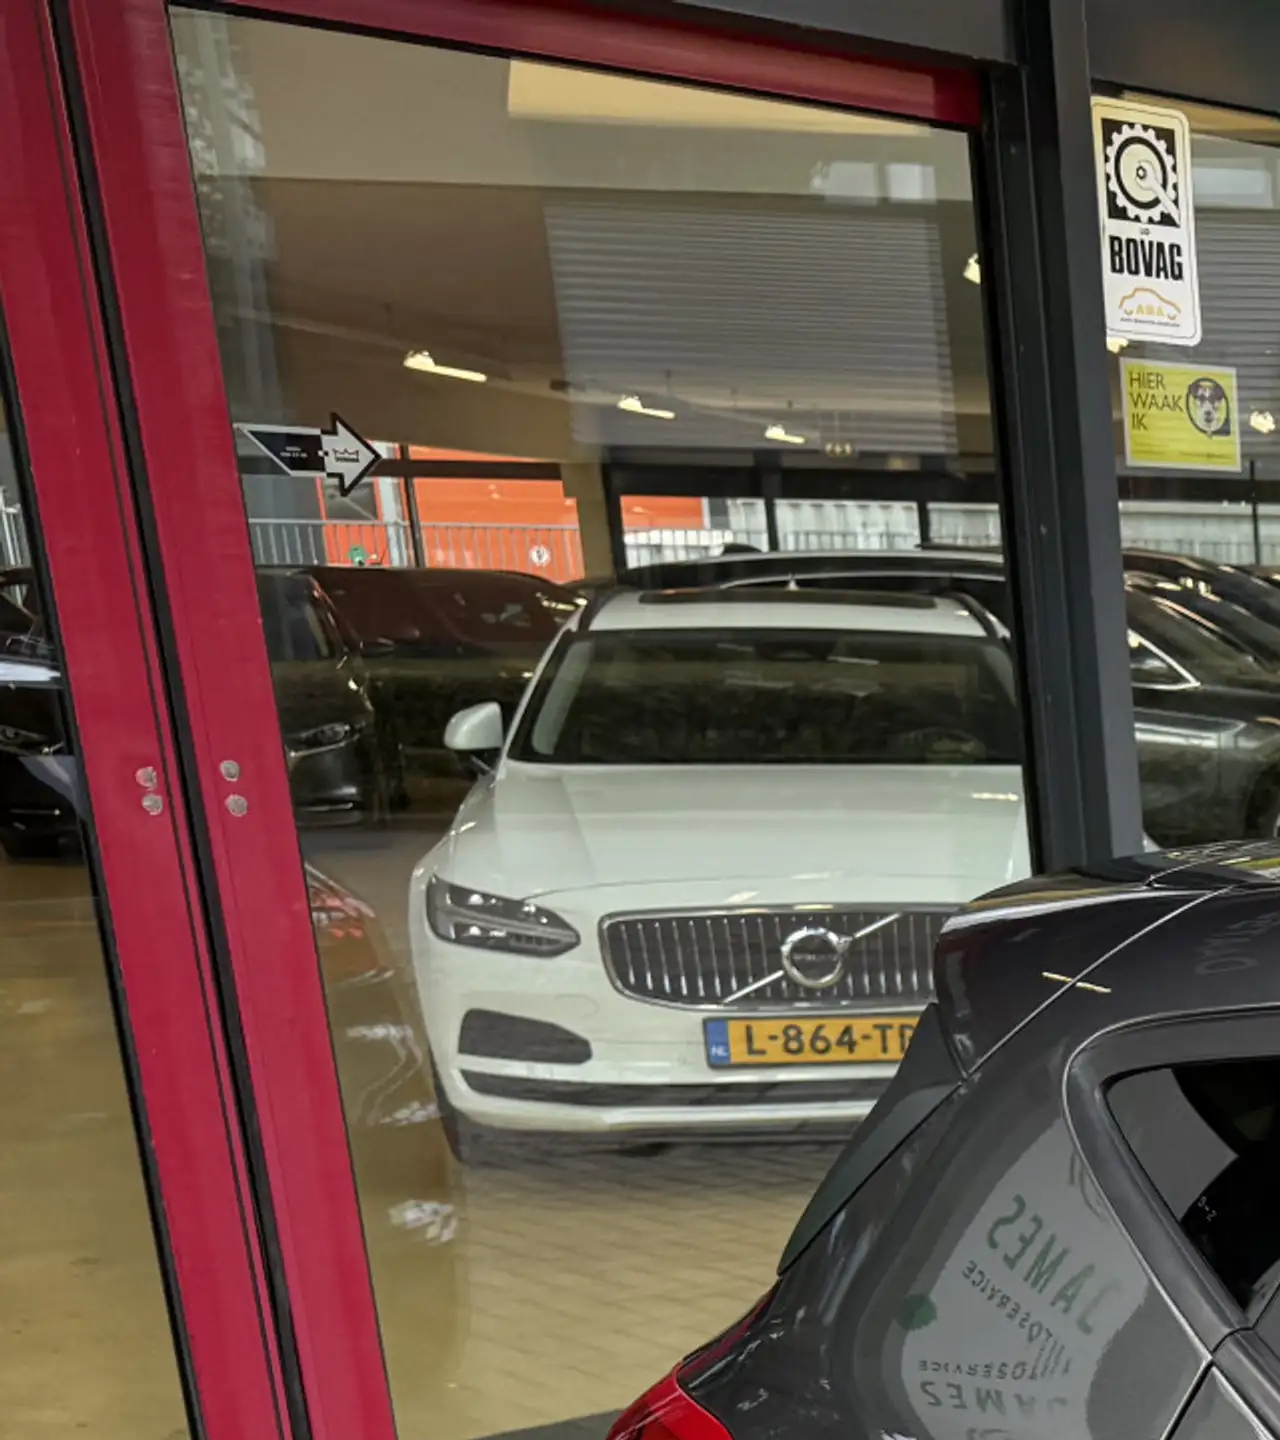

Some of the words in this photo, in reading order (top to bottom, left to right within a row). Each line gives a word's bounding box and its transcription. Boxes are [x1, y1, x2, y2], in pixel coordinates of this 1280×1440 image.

[1108, 234, 1184, 281] BOVAG
[1129, 371, 1166, 390] HIER
[1130, 392, 1184, 413] WAAK
[1132, 413, 1148, 431] IK
